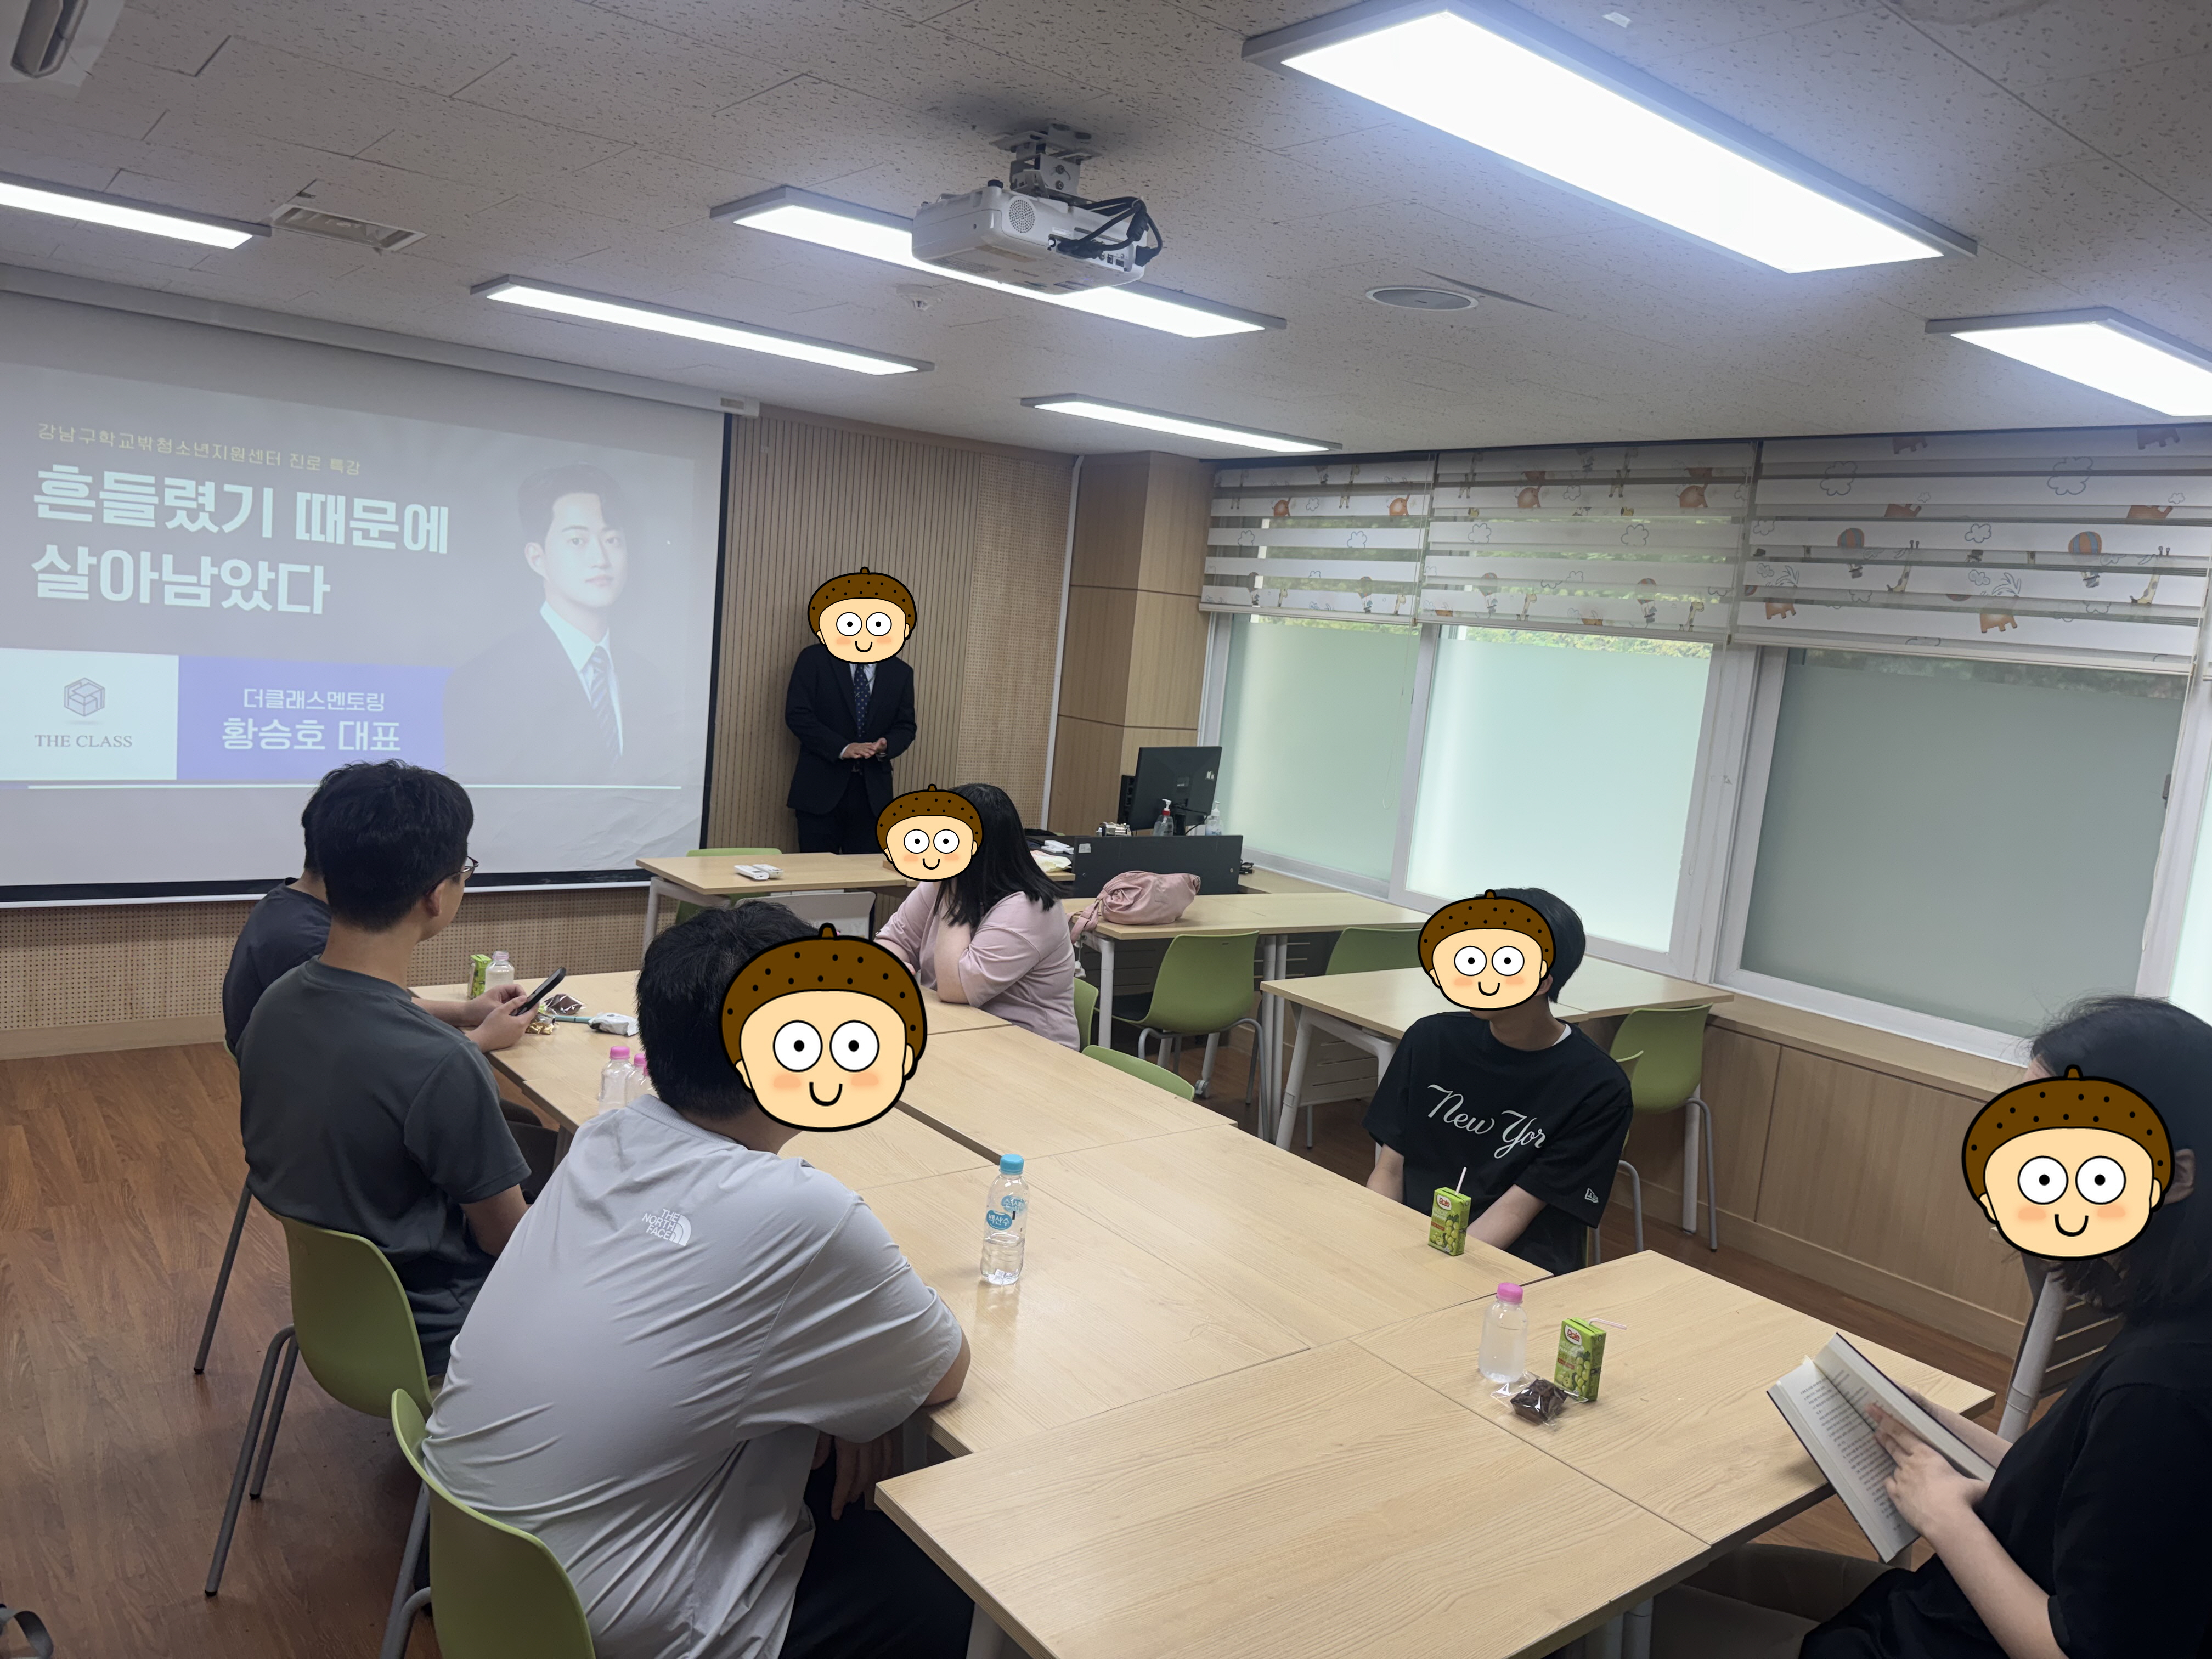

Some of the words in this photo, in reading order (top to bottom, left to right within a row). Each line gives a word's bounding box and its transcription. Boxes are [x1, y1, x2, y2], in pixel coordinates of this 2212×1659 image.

[38, 422, 281, 466] 강남구학교밖청소년지원센터
[290, 453, 321, 471] 진로
[330, 458, 360, 476] 특강
[33, 464, 274, 538] 흔들렸기
[296, 491, 449, 554] 때문에
[31, 544, 331, 615] 살아남았다
[244, 689, 385, 712] 더클래스멘토링
[34, 735, 71, 747] THE
[76, 735, 133, 748] CLASS
[222, 718, 325, 750] 황승호
[338, 721, 401, 751] 대표
[1427, 1084, 1495, 1135] New
[642, 1212, 676, 1232] NORTH
[662, 1209, 680, 1222] THE
[988, 1214, 1010, 1227] 백산수
[646, 1224, 672, 1240] FACE
[1567, 1328, 1580, 1341] Dole
